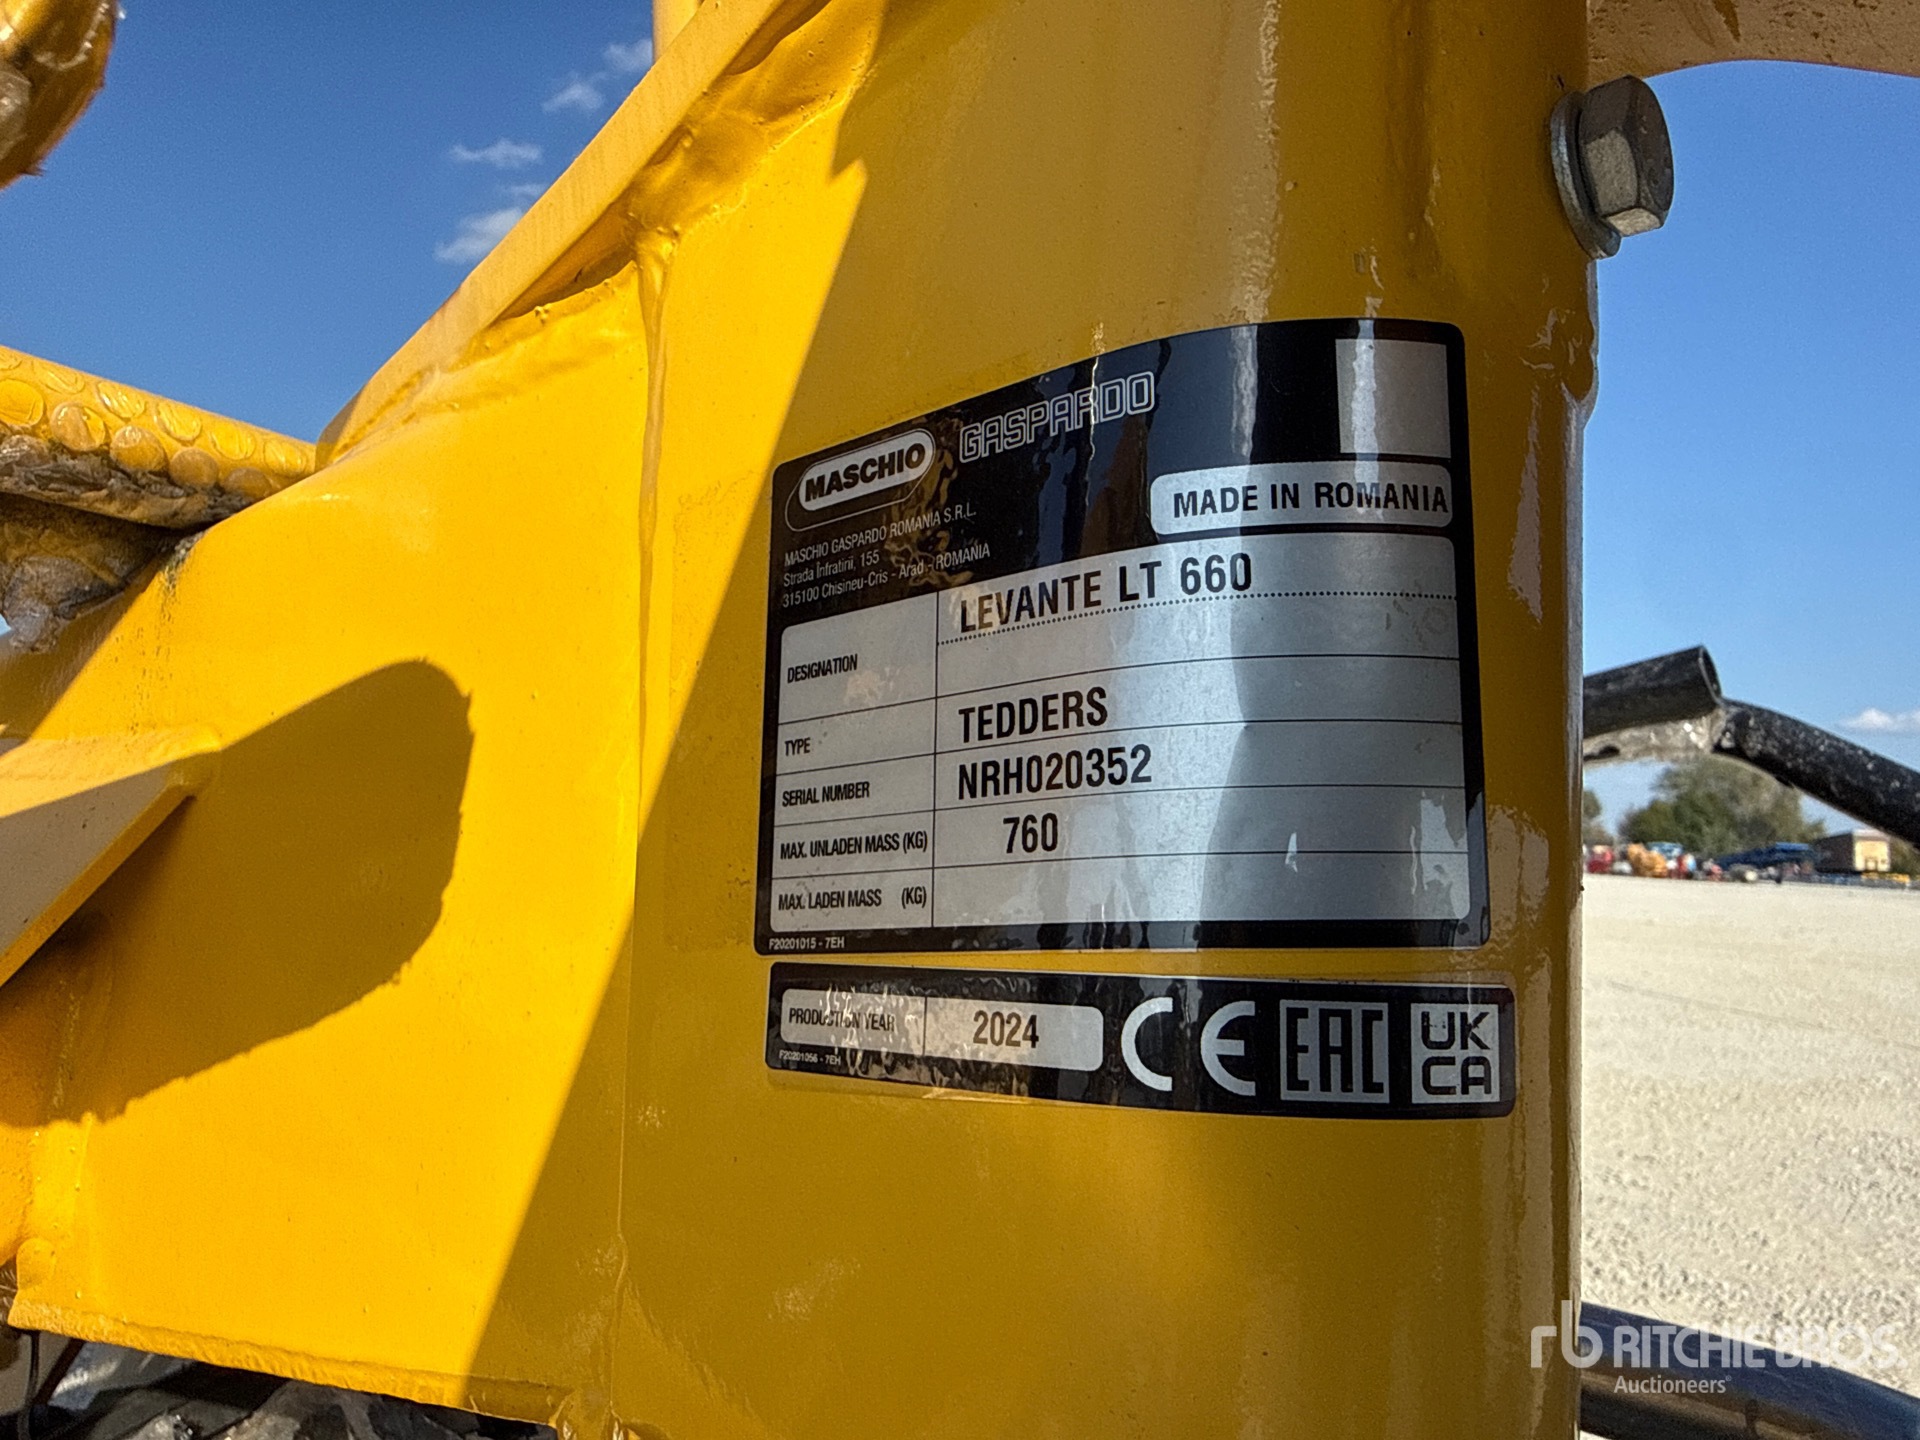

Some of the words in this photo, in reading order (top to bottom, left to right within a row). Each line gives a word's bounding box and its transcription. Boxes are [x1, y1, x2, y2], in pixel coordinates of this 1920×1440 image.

[959, 371, 1155, 463] GASPARDO
[804, 442, 926, 502] MASCHIO
[1173, 485, 1258, 518] MADE
[1271, 483, 1300, 509] IN
[1314, 482, 1449, 513] ROMANIA
[784, 543, 828, 567] MASCHIO
[831, 526, 887, 554] GASPARDO
[890, 513, 941, 539] ROMANIA
[943, 502, 977, 523] S.R.L.
[782, 587, 819, 608] 315100
[821, 571, 888, 599] Chisineu-Cris
[898, 560, 924, 579] Arad
[936, 543, 991, 570] ROMANIA
[783, 568, 814, 587] Strada
[861, 550, 880, 566] 155
[960, 571, 1102, 633] LEVANTE
[1119, 561, 1163, 603] LT
[1180, 552, 1252, 594] 660
[787, 654, 858, 683] DESIGNATION
[958, 687, 1108, 743] TEDDERS
[784, 737, 811, 756] TYPE
[958, 744, 1152, 800] NRH020352
[782, 788, 819, 807] SERIAL
[822, 781, 870, 802] NUMBER
[780, 841, 807, 860] MAX.
[810, 836, 862, 857] UNLADEN
[865, 833, 899, 853] MASS
[903, 831, 928, 853] (KG)
[1003, 813, 1058, 854] 760
[778, 894, 805, 910] MAX.
[808, 891, 845, 909] LADEN
[848, 889, 882, 907] MASS
[901, 886, 927, 909] (KG)
[769, 938, 816, 950] F20201015
[825, 936, 845, 949] 7EH
[789, 1008, 860, 1029] PRODUCTION
[864, 1013, 895, 1032] YEAR
[973, 1010, 1039, 1048] 2024
[1421, 1011, 1490, 1051] UK
[1421, 1055, 1492, 1095] CA
